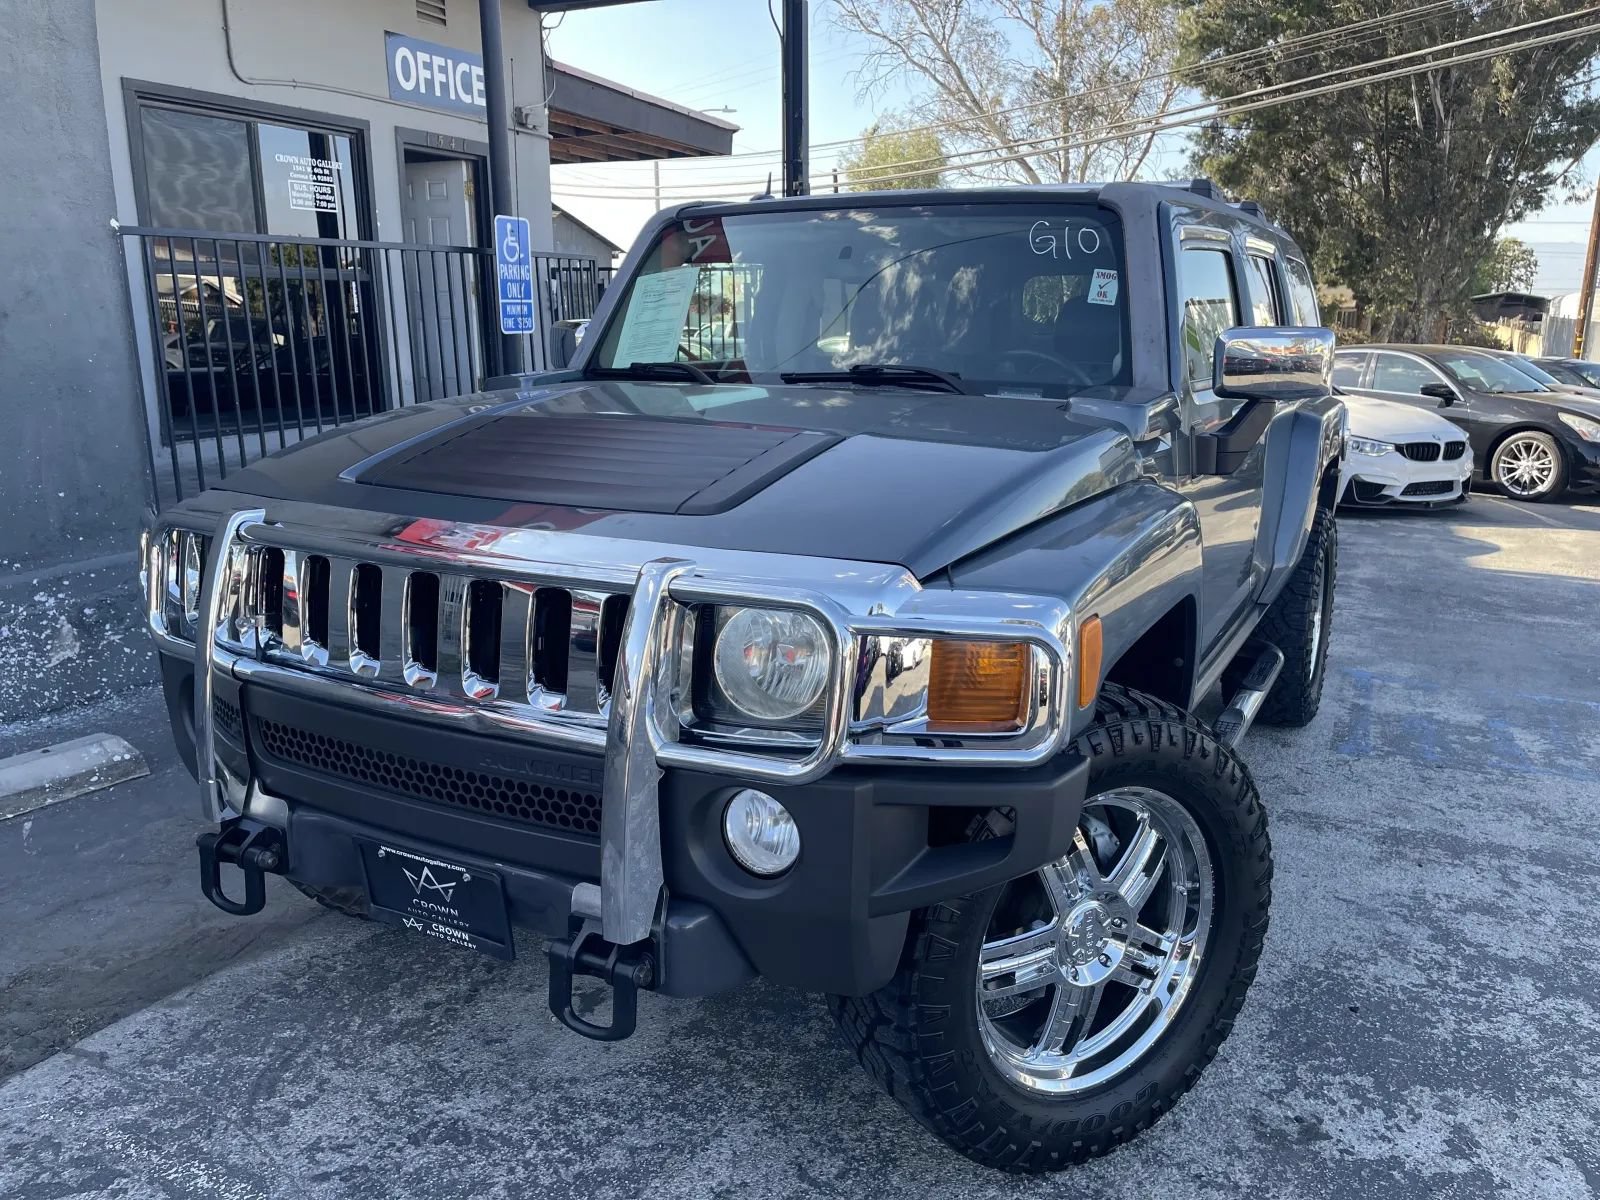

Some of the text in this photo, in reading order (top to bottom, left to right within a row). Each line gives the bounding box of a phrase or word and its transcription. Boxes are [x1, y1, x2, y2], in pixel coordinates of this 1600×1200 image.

[394, 46, 487, 107] OFFICE
[275, 153, 343, 170] CROWN AUTO GALLERY
[309, 185, 331, 194] HOURS
[316, 193, 335, 202] Sunday
[500, 264, 530, 280] PARKING
[1095, 271, 1118, 281] SMOG
[506, 282, 525, 299] ONLY
[1096, 290, 1108, 299] OK
[504, 317, 515, 328] FINE
[380, 845, 467, 873] www.crownautogallery.com
[412, 898, 459, 917] CROWN
[426, 930, 477, 950] AUTO GALLERY
[432, 923, 469, 941] CROWN
